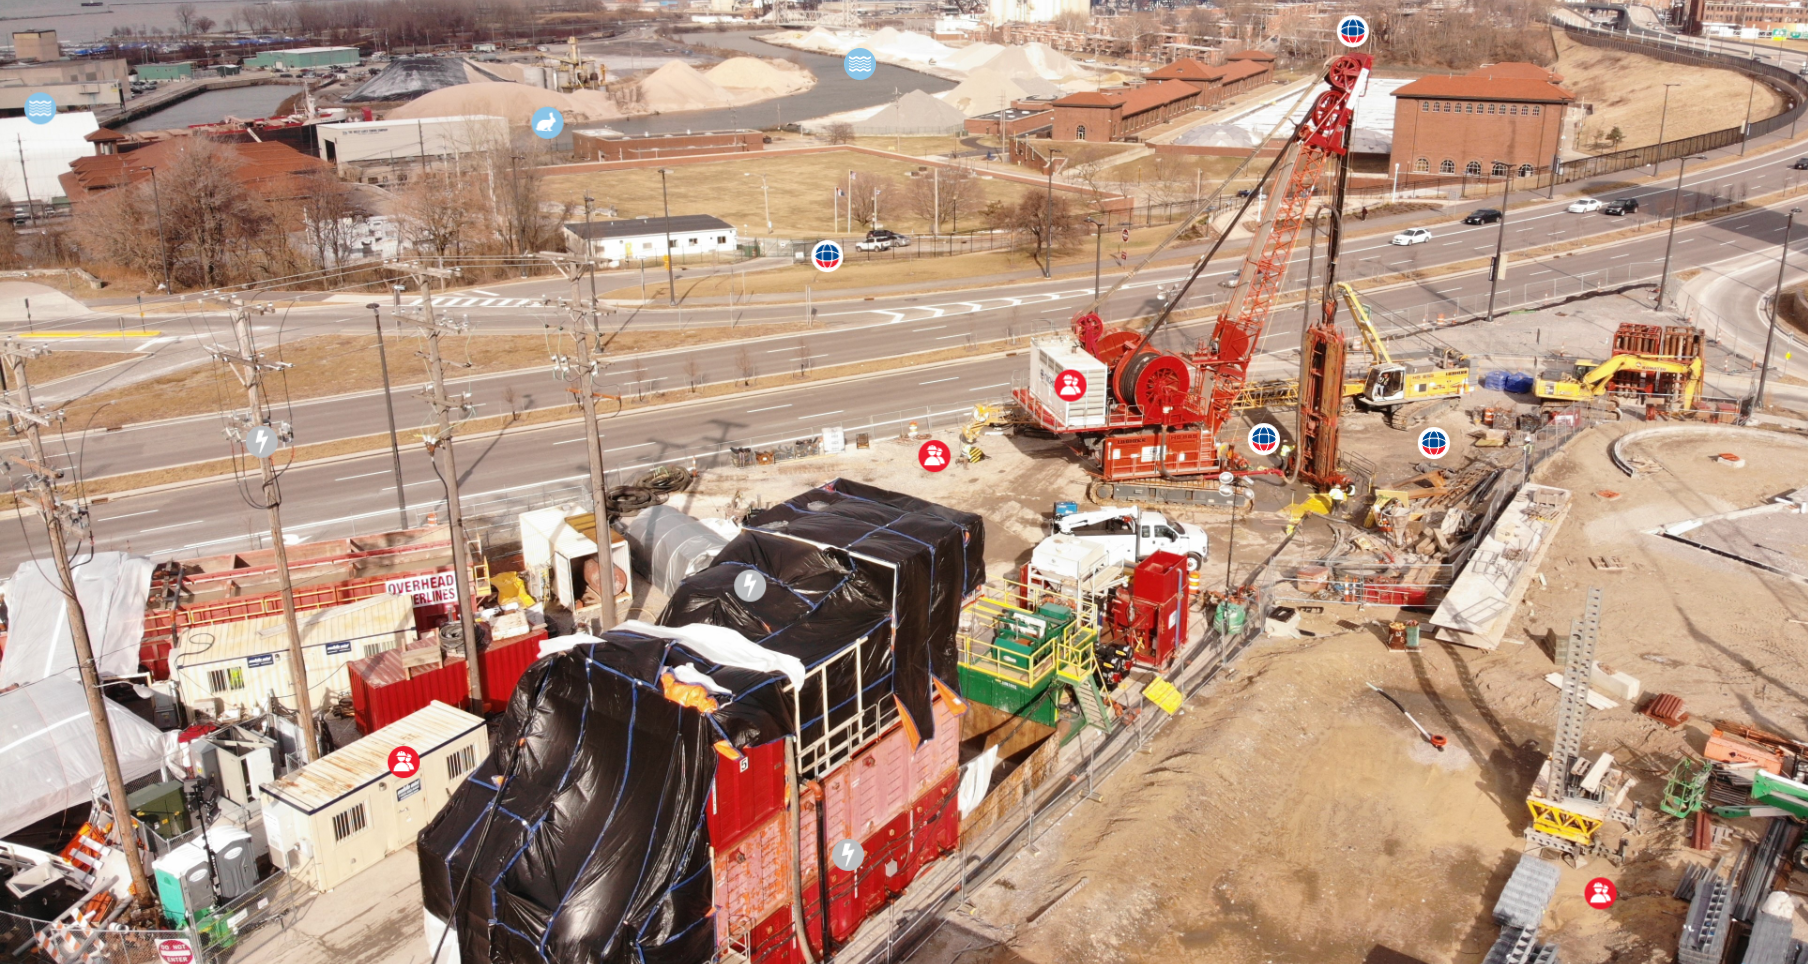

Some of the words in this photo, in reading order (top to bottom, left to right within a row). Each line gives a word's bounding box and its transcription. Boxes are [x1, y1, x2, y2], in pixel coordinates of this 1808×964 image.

[388, 574, 454, 595] OVERHEAD
[413, 588, 456, 605] ERLINES
[741, 759, 747, 770] 5
